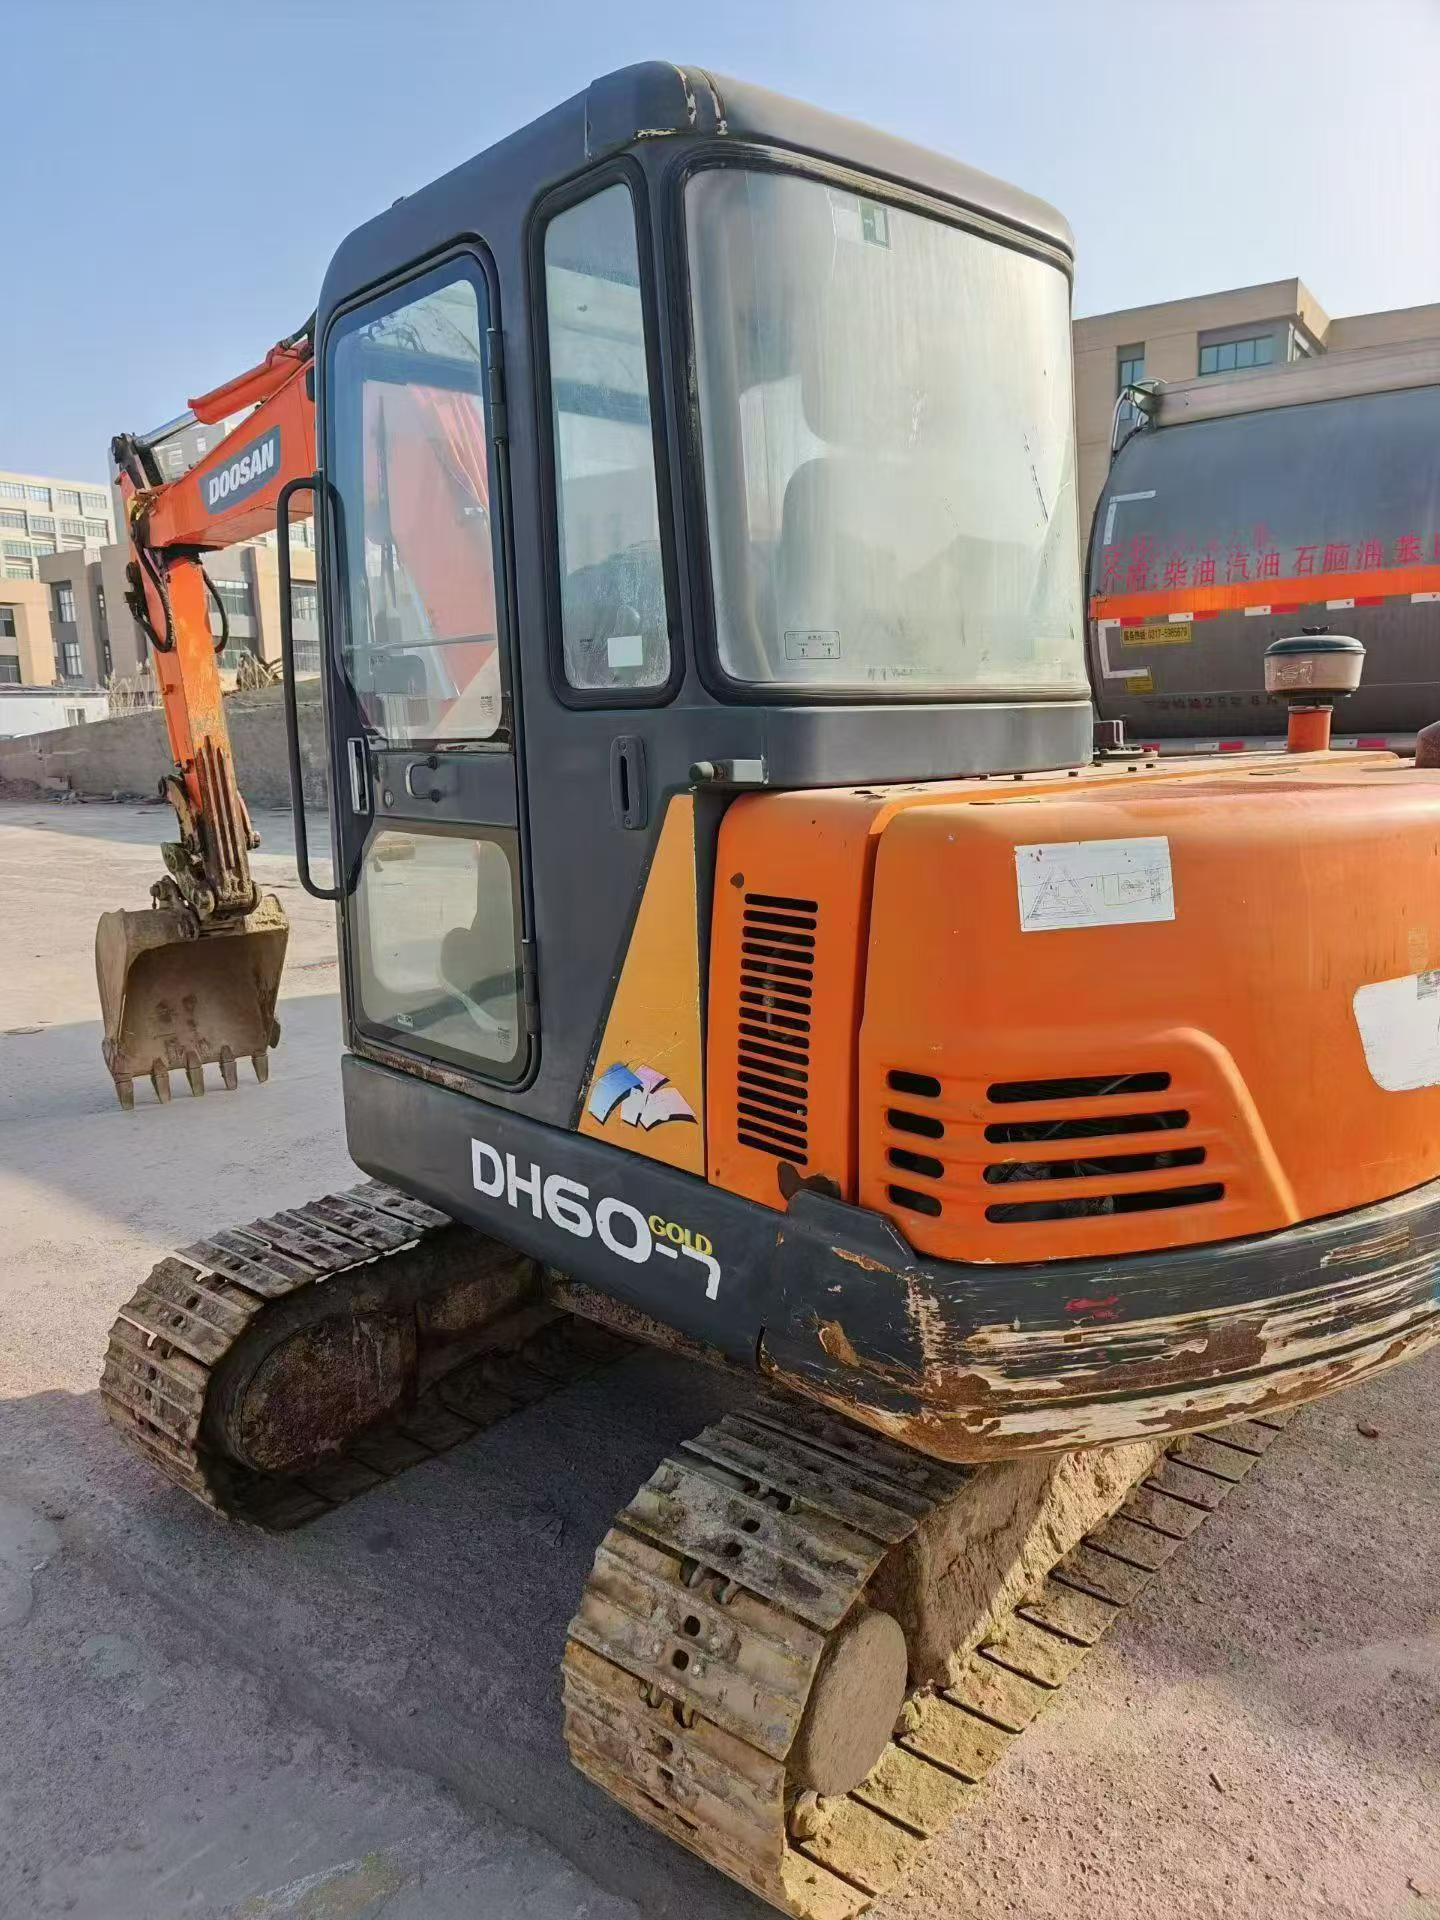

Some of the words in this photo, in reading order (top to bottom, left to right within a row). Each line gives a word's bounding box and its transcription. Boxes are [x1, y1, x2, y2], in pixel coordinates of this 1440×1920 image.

[208, 438, 275, 505] DOOSAN
[471, 1137, 721, 1300] DH60-7
[648, 1215, 713, 1255] GOLD
